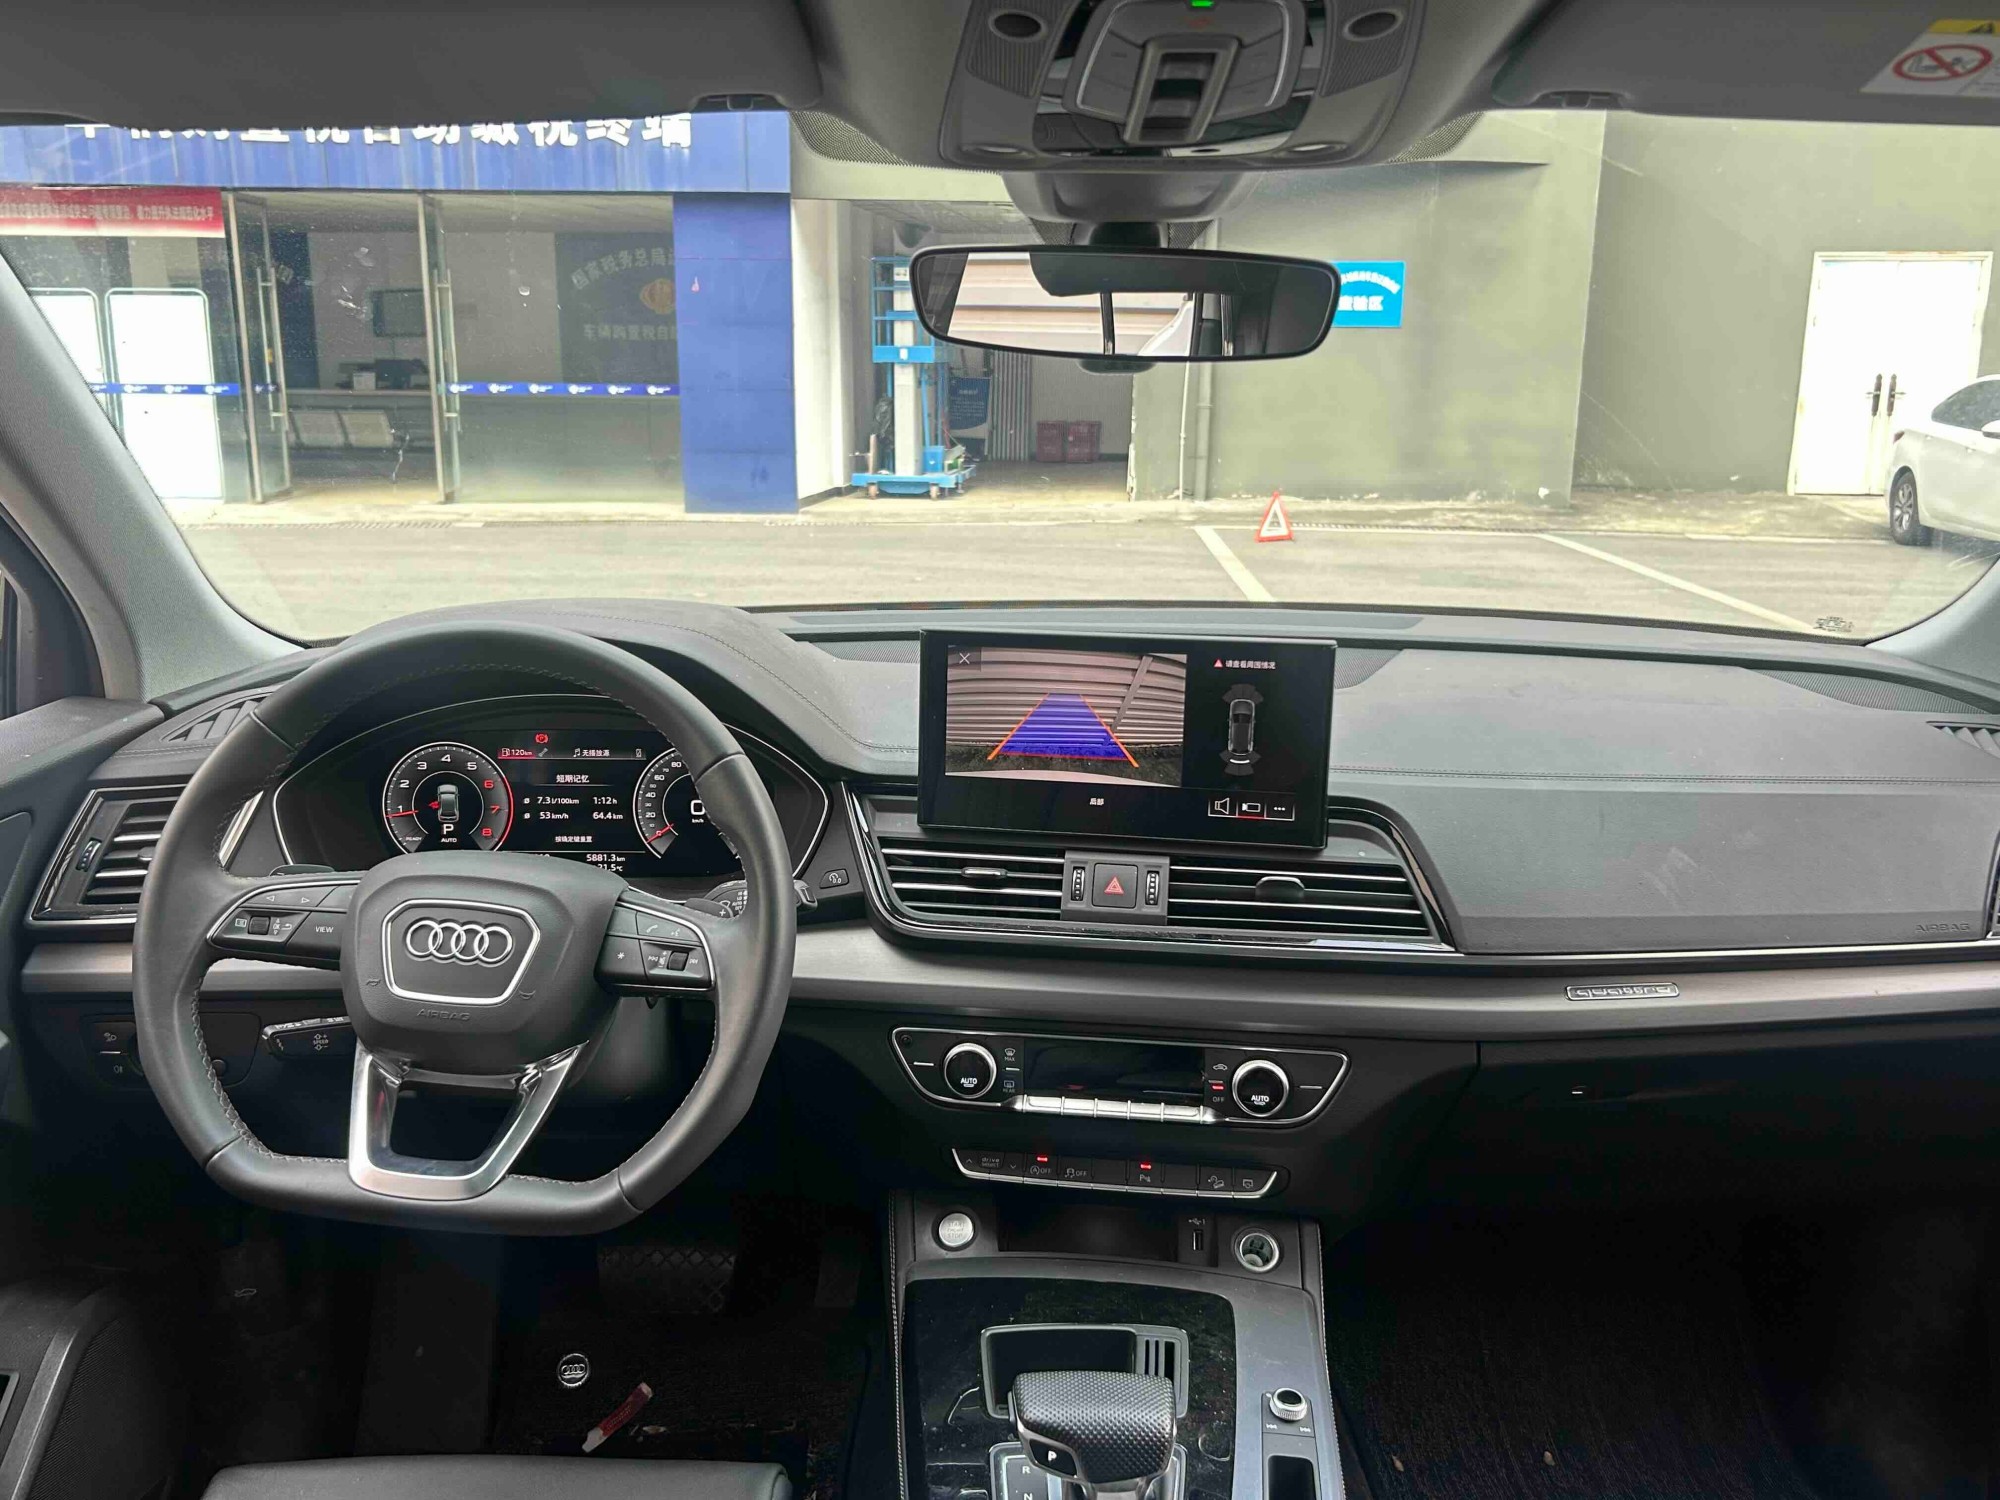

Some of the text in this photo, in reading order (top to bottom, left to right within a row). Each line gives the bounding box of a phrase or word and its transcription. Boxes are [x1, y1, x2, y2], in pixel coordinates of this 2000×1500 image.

[581, 749, 610, 757] 无播放源
[441, 754, 451, 762] 4
[417, 761, 428, 770] 3
[467, 761, 478, 771] 5
[400, 779, 410, 788] 2
[555, 774, 590, 784] 短期记忆
[484, 780, 494, 789] 6
[1090, 798, 1105, 806] 后部
[490, 805, 500, 814] 7
[540, 811, 551, 820] 53
[443, 823, 454, 835] P
[482, 828, 492, 837] 8
[1915, 922, 1971, 933] AIRBAG
[1251, 1094, 1270, 1103] AUTO
[1047, 1450, 1057, 1462] P
[1022, 1466, 1031, 1474] R
[1023, 1492, 1032, 1500] N
